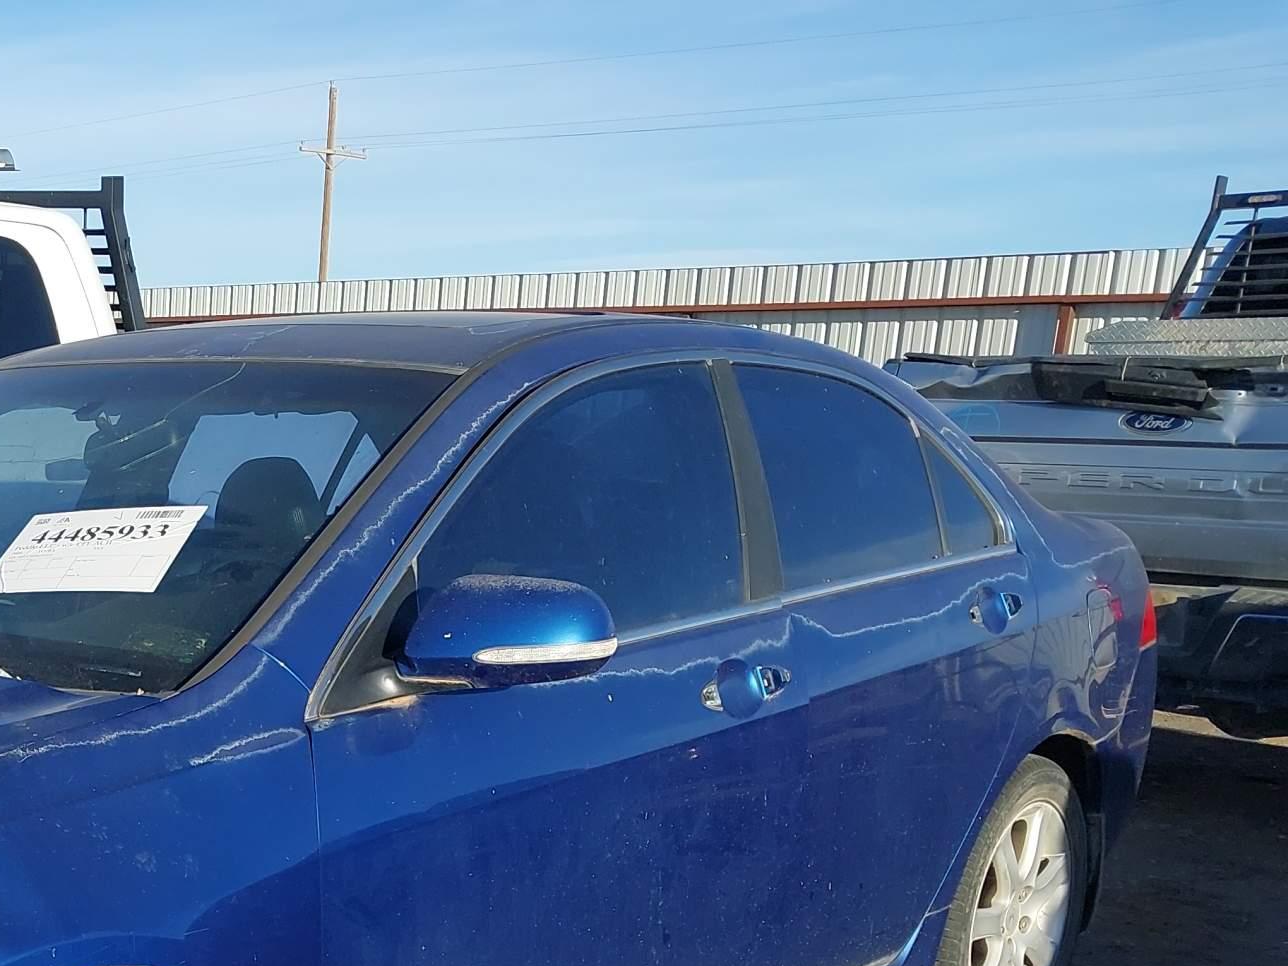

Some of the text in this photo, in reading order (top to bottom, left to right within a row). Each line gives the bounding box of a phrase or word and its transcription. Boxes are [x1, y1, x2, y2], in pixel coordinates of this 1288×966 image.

[1134, 413, 1176, 429] Ford
[1004, 467, 1165, 491] PER
[31, 523, 170, 544] 44485933
